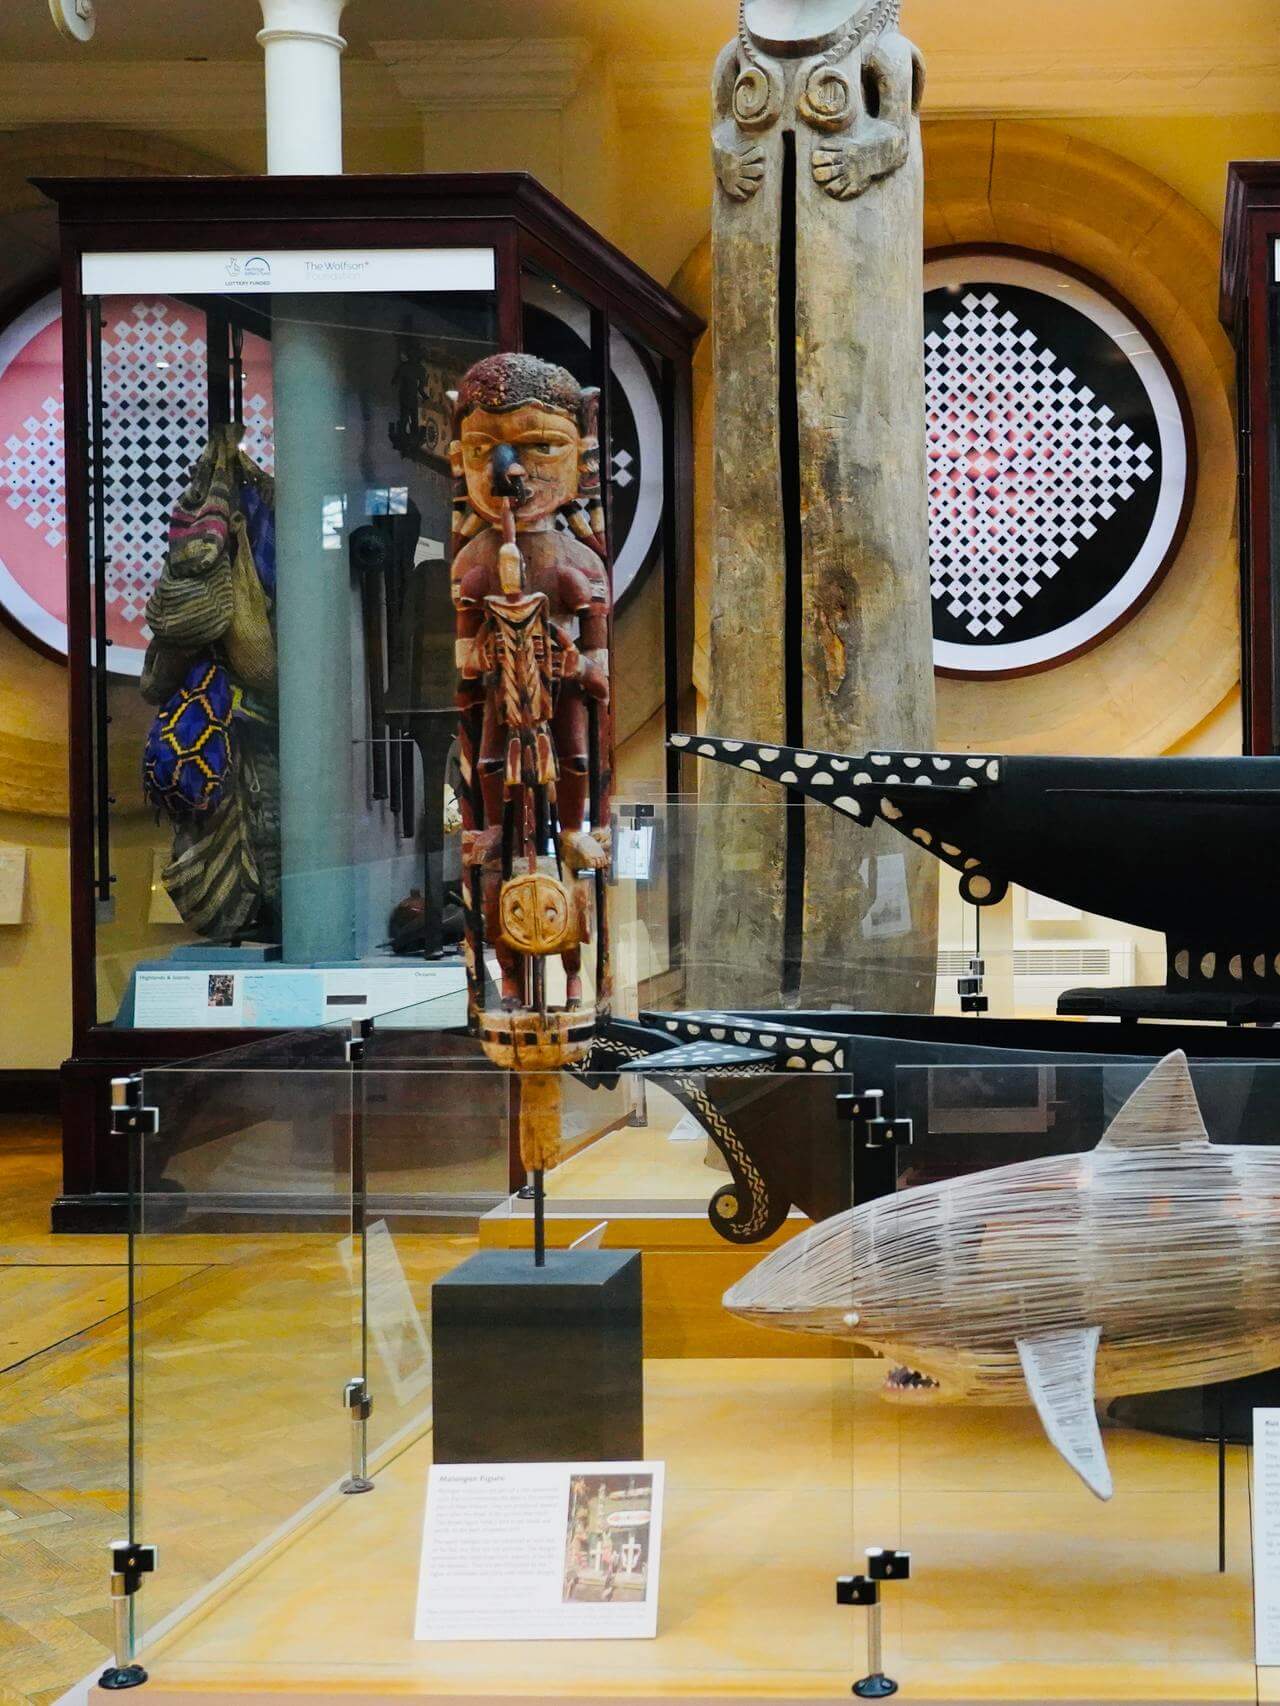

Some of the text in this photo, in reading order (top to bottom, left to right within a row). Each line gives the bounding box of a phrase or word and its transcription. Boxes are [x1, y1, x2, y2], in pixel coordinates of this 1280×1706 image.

[304, 261, 323, 271] The
[305, 271, 361, 281] Foundation
[479, 1475, 505, 1484] Figure
